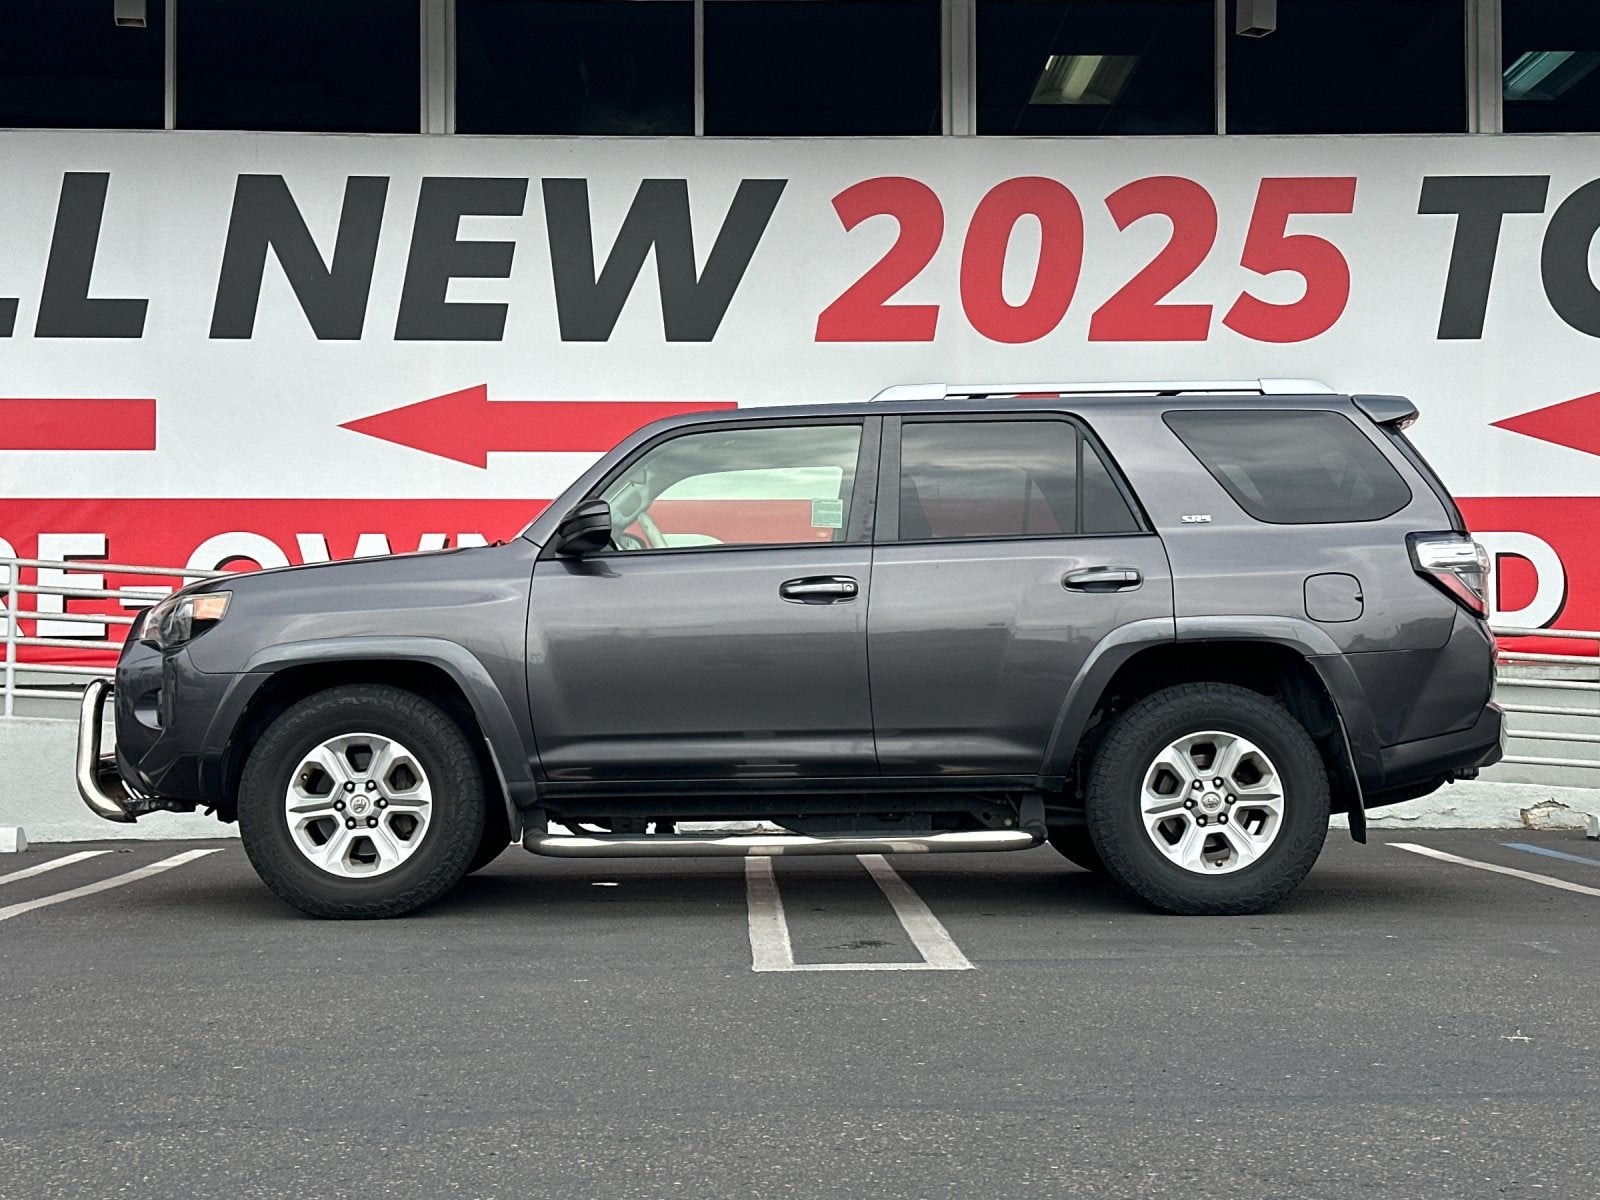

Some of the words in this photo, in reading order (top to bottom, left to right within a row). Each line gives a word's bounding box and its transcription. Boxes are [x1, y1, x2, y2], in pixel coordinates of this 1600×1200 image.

[0, 172, 149, 338] L
[209, 174, 788, 342] NEW
[814, 176, 1357, 343] 2025
